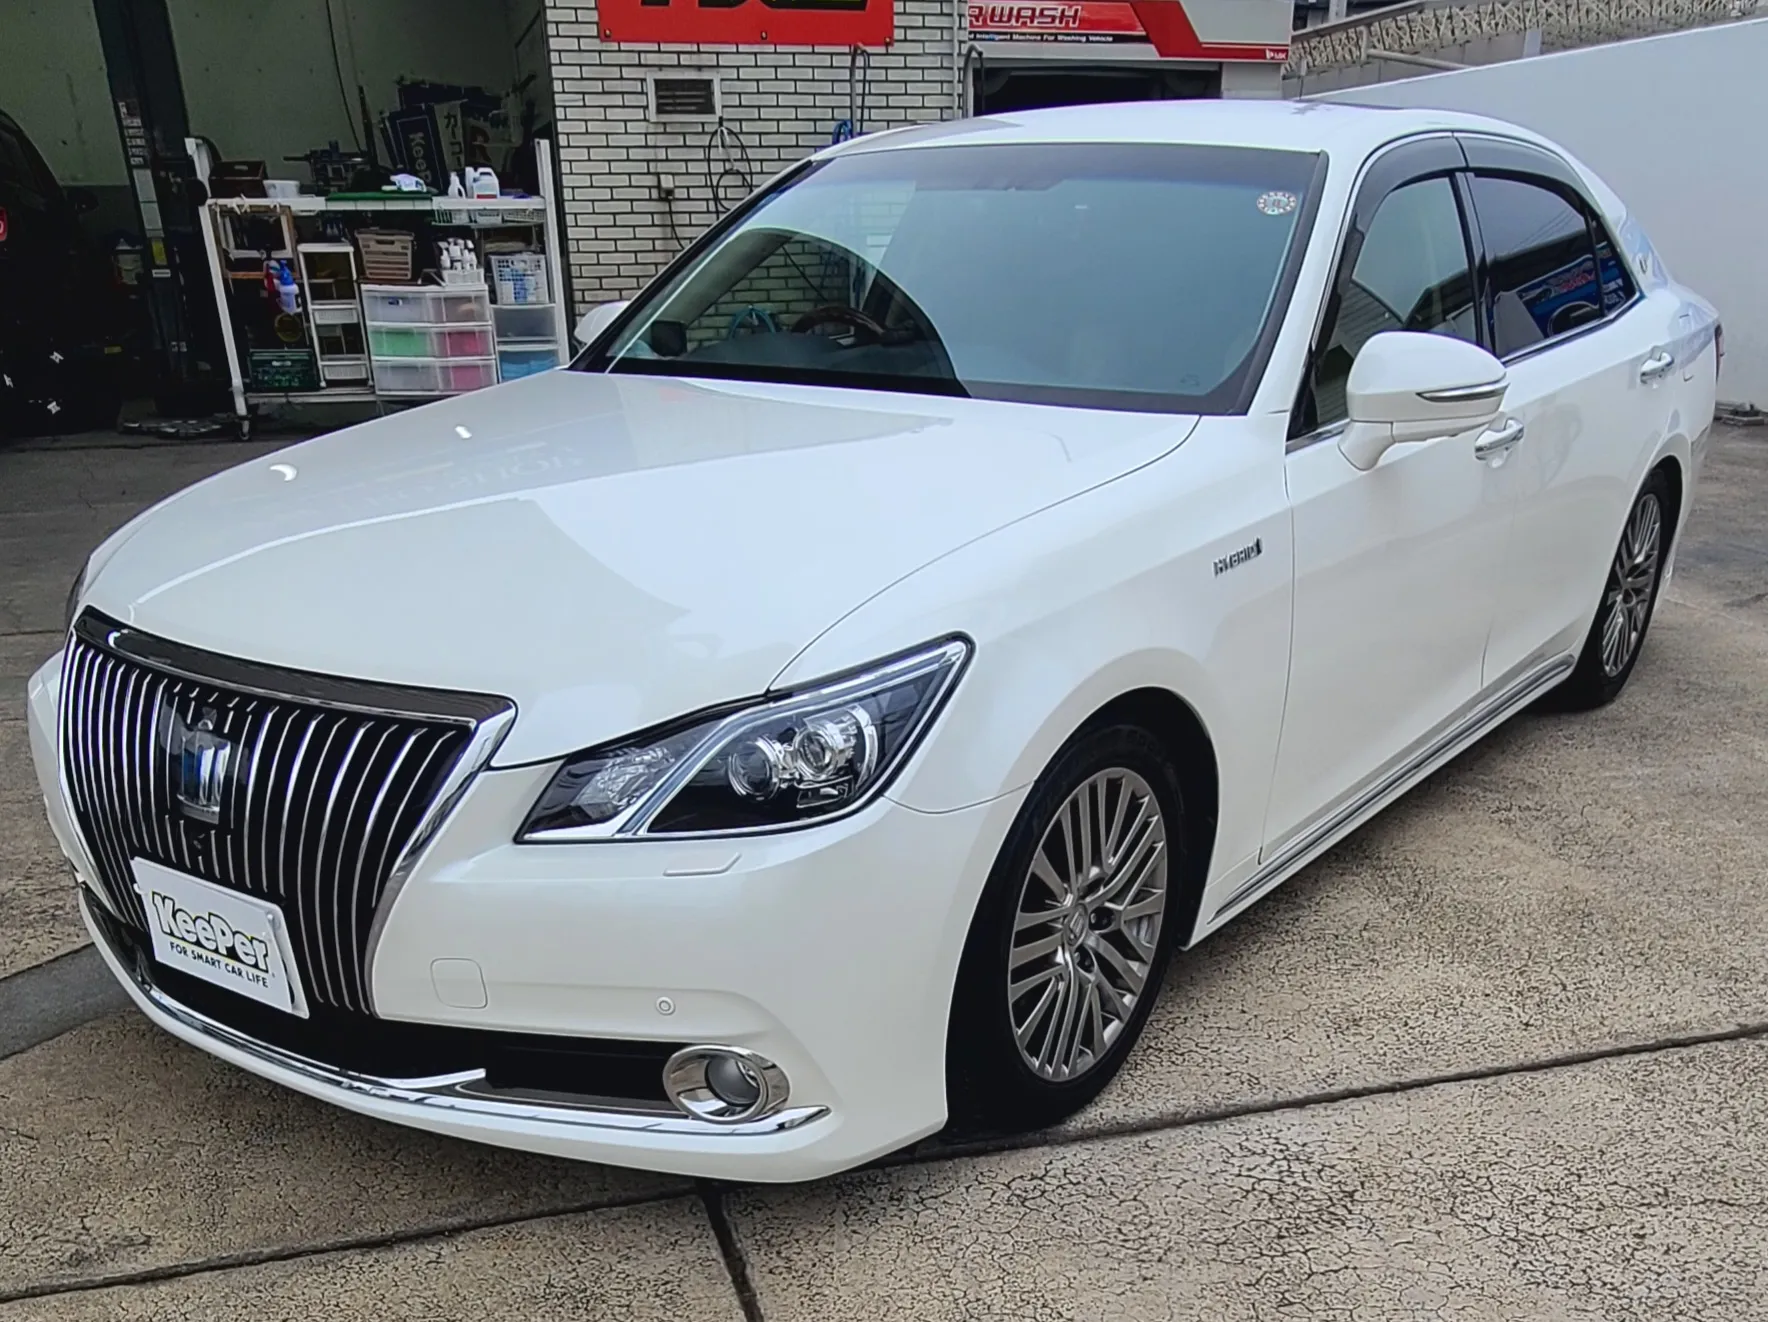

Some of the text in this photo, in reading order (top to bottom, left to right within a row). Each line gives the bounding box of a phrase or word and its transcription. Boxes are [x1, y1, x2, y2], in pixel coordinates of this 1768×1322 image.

[988, 4, 1082, 27] WASH
[1213, 543, 1258, 577] HYBRID
[152, 891, 269, 973] KeePer
[170, 942, 269, 988] FOR SMART CAR LIFE
